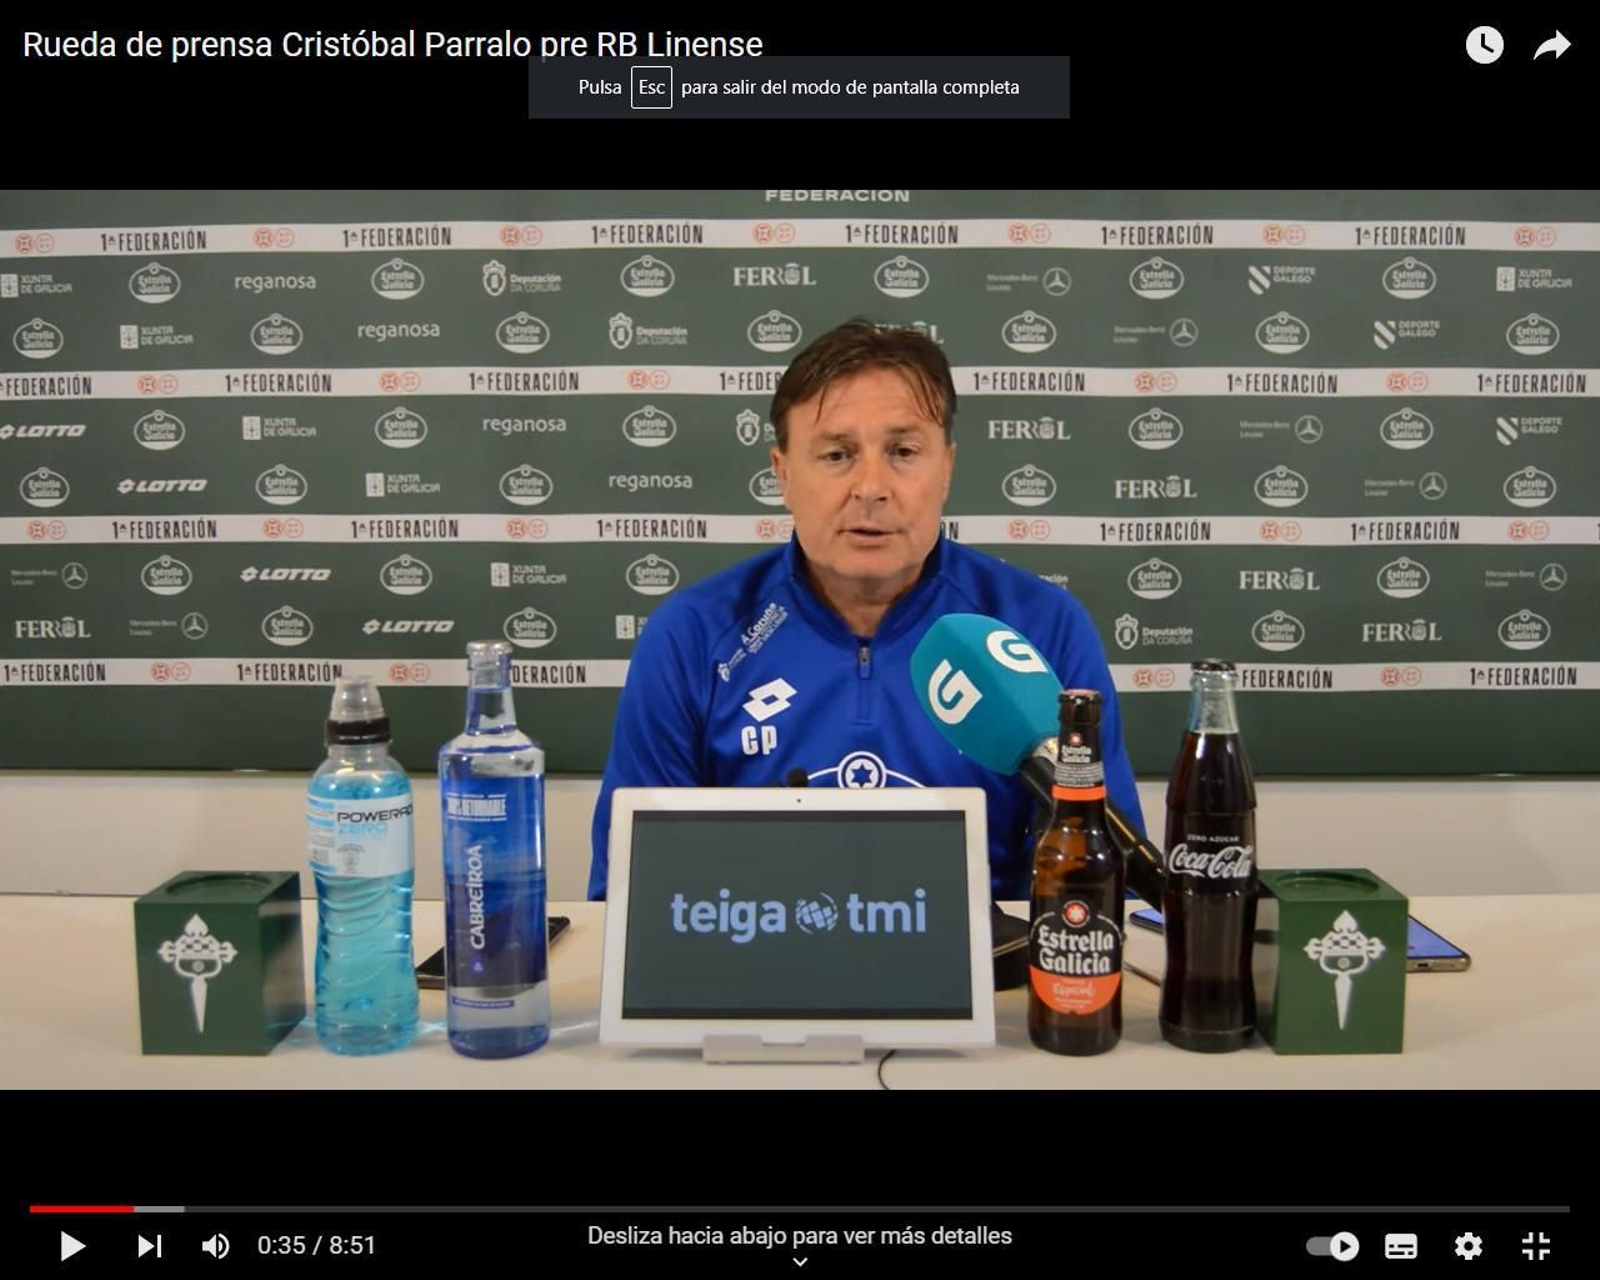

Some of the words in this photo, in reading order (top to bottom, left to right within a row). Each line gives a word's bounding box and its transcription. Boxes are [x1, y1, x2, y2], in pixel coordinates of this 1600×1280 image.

[118, 228, 207, 252] FEDERACIÓN
[361, 223, 452, 248] FEDERACIÓN
[610, 222, 703, 244] FEDERACIÓN
[864, 222, 959, 244] FEDERACIÓN
[1120, 222, 1213, 245] FEDERACIÓN
[1374, 224, 1466, 246] FEDERACIÓN
[1273, 266, 1316, 275] DEPORTE
[1273, 275, 1312, 284] GALEGO
[234, 273, 317, 294] reganosa
[357, 321, 441, 341] reganosa
[1398, 321, 1440, 330] DEPORTE
[1398, 330, 1436, 338] GALEGO
[6, 374, 92, 396] FEDERACIÓN
[243, 371, 332, 392] FEDERACIÓN
[487, 369, 579, 391] FEDERACIÓN
[992, 370, 1085, 391] FEDERACIÓN
[1246, 370, 1337, 393] FEDERACIÓN
[1495, 372, 1586, 393] FEDERACIÓN
[16, 424, 87, 438] LOTTO
[482, 416, 567, 436] reganosa
[1520, 417, 1563, 426] DEPORTE
[1520, 426, 1559, 434] GALEGO
[136, 479, 208, 493] LOTTO
[609, 473, 693, 492] reganosa
[130, 517, 217, 539] FEDERACIÓN
[369, 517, 459, 538] FEDERACIÓN
[615, 517, 707, 538] FEDERACIÓN
[1118, 519, 1211, 542] FEDERACIÓN
[1369, 519, 1460, 541] FEDERACIÓN
[259, 567, 331, 581] LOTTO
[381, 619, 455, 633] LOTTO
[21, 661, 106, 682] FEDERACIÓN
[255, 661, 342, 681] FEDERACIÓN
[1242, 667, 1333, 689] FEDERACIÓN
[1487, 665, 1577, 686] FEDERACIÓN
[671, 887, 787, 944] teiga
[846, 887, 927, 933] tmi
[1038, 925, 1114, 952] Estrella
[1039, 947, 1111, 975] Galicia
